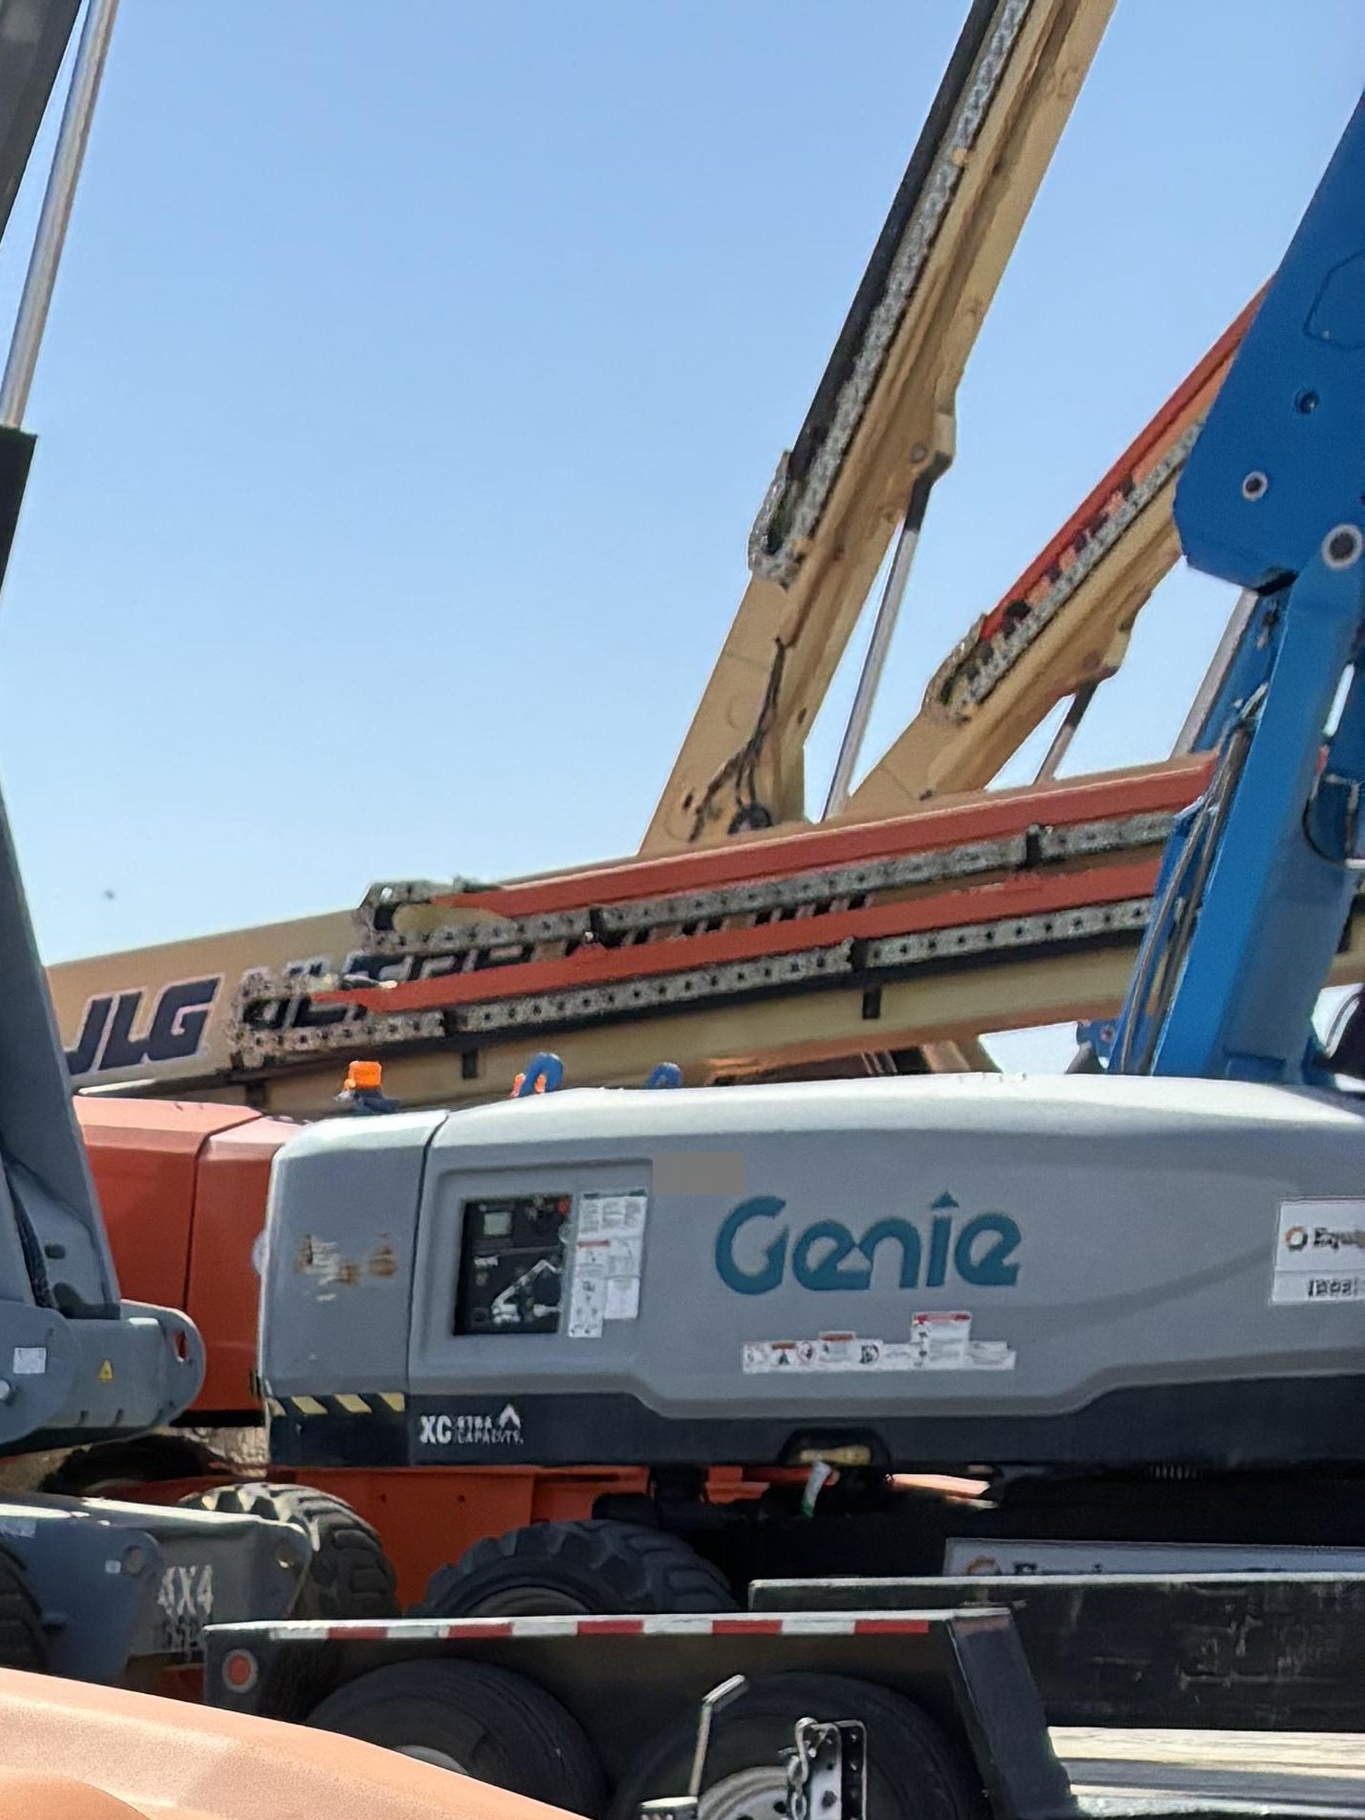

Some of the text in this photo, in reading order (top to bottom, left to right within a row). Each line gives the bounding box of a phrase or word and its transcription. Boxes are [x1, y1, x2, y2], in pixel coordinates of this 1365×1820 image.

[65, 973, 224, 1075] JLG
[715, 1190, 1022, 1295] Genie
[420, 1415, 452, 1444] XC
